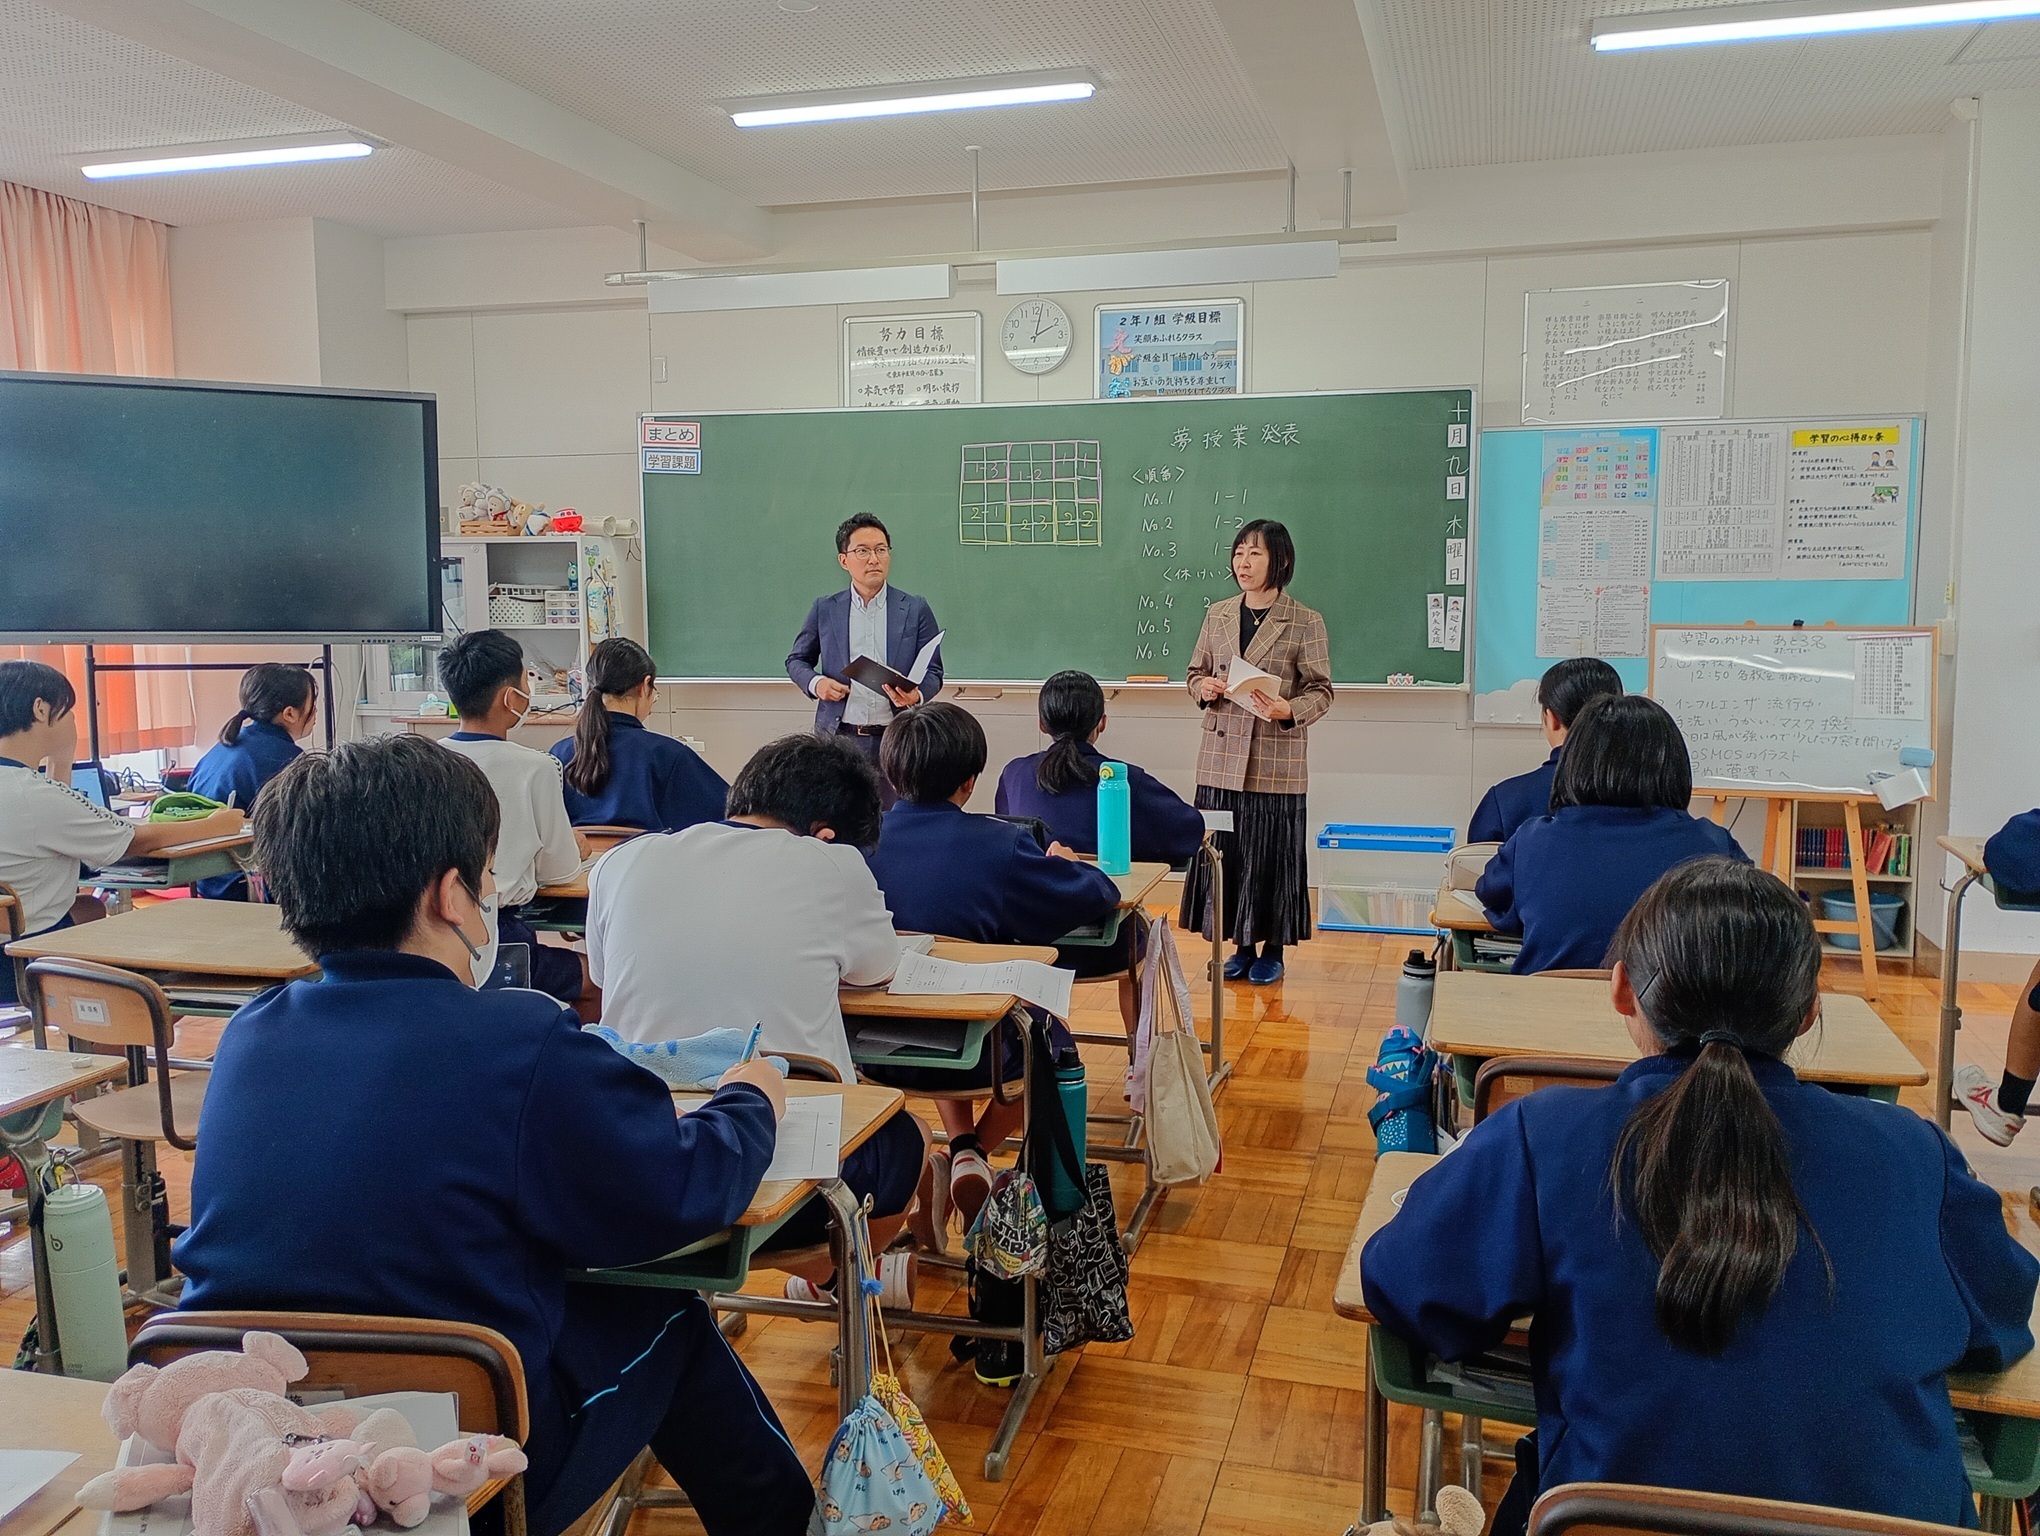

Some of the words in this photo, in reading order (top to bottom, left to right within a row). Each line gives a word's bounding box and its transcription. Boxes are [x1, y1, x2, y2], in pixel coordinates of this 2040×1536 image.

[1020, 308, 1028, 318] 11
[1032, 306, 1040, 315] 12
[1011, 319, 1019, 328] 10
[1053, 317, 1059, 326] 2
[1120, 314, 1166, 327] 2年1組
[1172, 311, 1221, 325] 学級目標
[880, 325, 945, 341] 努力目標
[1009, 332, 1015, 341] 9
[1058, 330, 1064, 339] 3
[1134, 333, 1203, 344] 笑顔あふれるクラス
[1134, 352, 1216, 363] 学級全員で協力し合う
[1210, 361, 1231, 370] クラス
[864, 384, 904, 396] 本気で学習
[923, 382, 960, 394] 明るい挨拶
[648, 427, 694, 441] まとめ
[1809, 432, 1884, 444] 学習の心得8ヶ条
[648, 454, 696, 469] 学習課題
[1143, 490, 1174, 507] No.1
[1142, 516, 1174, 532] No.2
[1143, 541, 1177, 558] No.3
[1214, 542, 1232, 555] 1-
[1138, 594, 1174, 610] No.4
[1137, 619, 1171, 636] No.5
[1136, 642, 1170, 660] No.6
[1690, 670, 1729, 682] 12:50
[1676, 697, 1760, 711] インフルエンザ
[1690, 748, 1800, 762] OSMOSのイラスト
